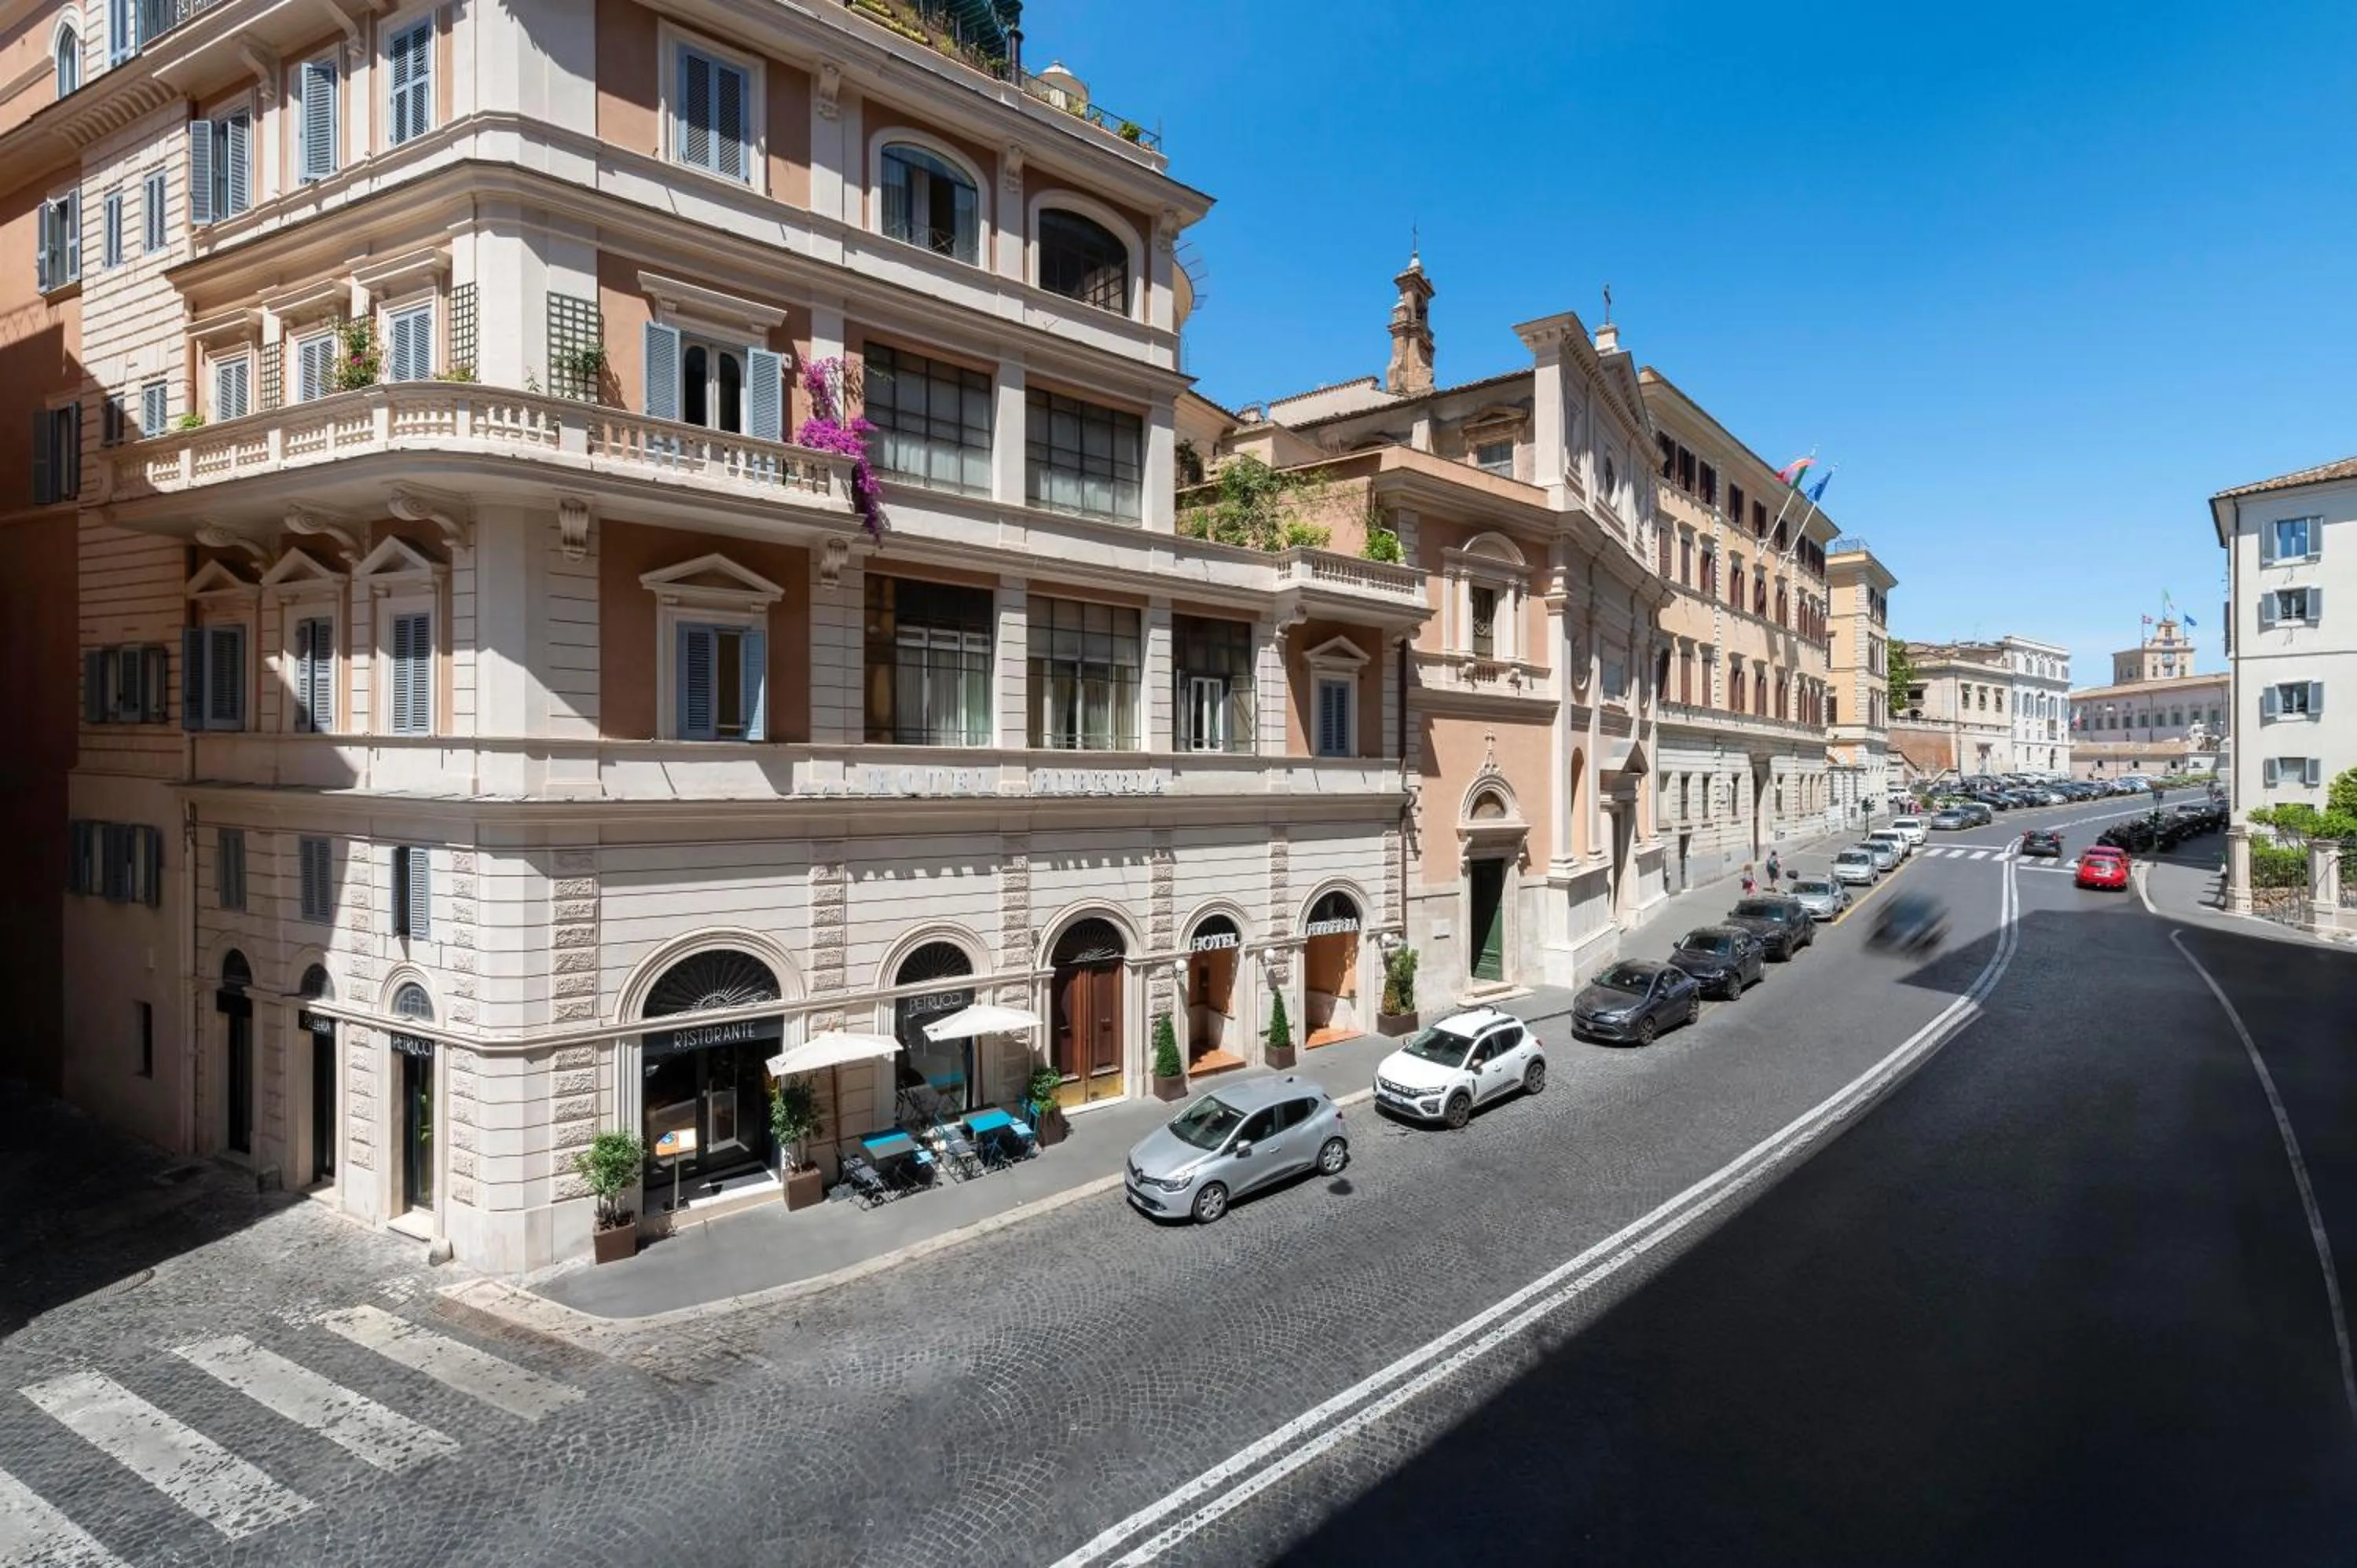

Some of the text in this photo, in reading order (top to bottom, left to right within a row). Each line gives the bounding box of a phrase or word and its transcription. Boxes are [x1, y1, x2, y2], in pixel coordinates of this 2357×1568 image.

[1192, 932, 1239, 951] HOTEL
[908, 992, 962, 1011] PETRUCCI
[394, 1035, 433, 1056] PETRUCCI
[673, 1022, 755, 1050] RISTORANTE
